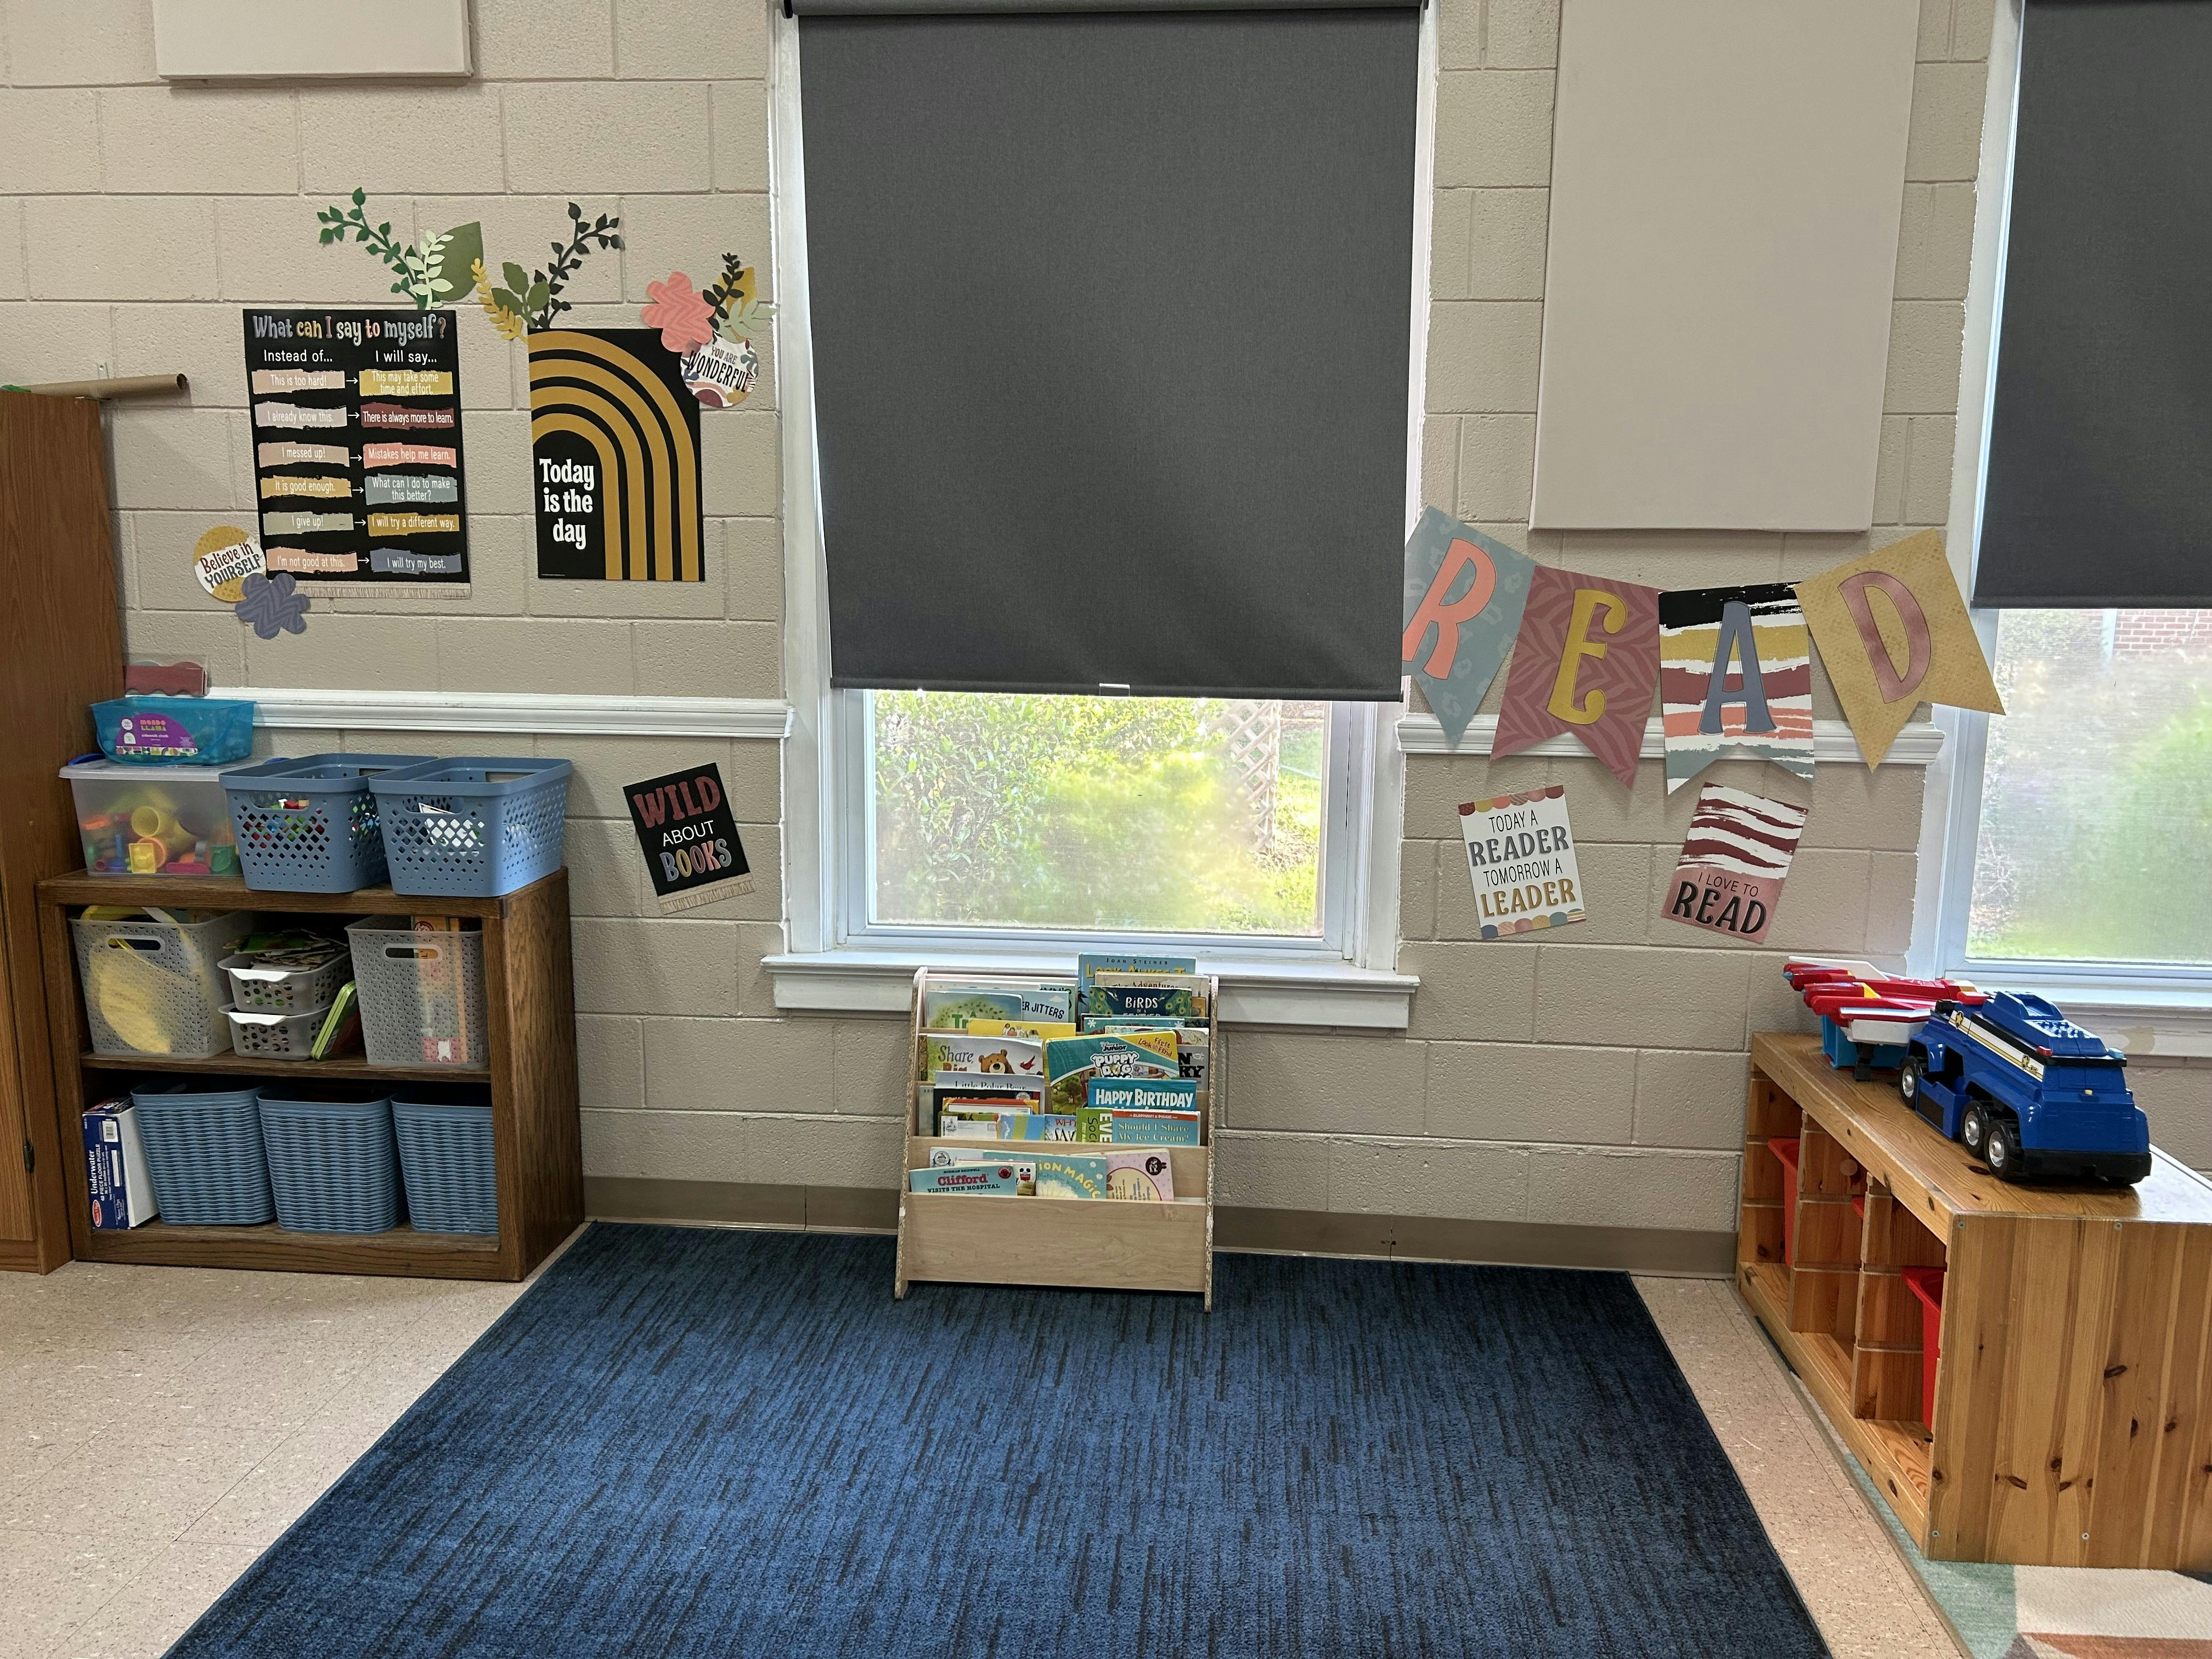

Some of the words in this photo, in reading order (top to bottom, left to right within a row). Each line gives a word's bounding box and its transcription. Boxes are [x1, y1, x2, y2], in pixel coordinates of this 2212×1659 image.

[252, 315, 292, 338] What
[296, 321, 322, 339] can
[325, 316, 332, 338] I
[337, 321, 362, 346] say
[365, 319, 380, 338] to
[264, 350, 307, 362] Instead
[313, 350, 332, 362] of...
[376, 351, 378, 362] I
[384, 349, 403, 362] will
[408, 352, 437, 365] say...
[712, 346, 723, 358] YOU
[724, 353, 737, 364] ARE
[372, 371, 386, 382] This
[388, 373, 401, 385] may
[403, 371, 417, 382] take
[420, 374, 438, 382] some
[686, 350, 749, 392] WONDERFUL
[270, 374, 284, 385] This
[287, 375, 292, 385] is
[295, 375, 306, 385] too
[308, 374, 326, 385] hard!
[381, 383, 394, 394] time
[397, 384, 409, 394] and
[411, 384, 433, 394] effort.
[268, 411, 270, 421] I
[273, 411, 297, 423] already
[300, 411, 317, 422] know
[320, 412, 334, 422] this.
[364, 411, 381, 422] There
[382, 412, 387, 422] is
[388, 412, 409, 425] always
[411, 414, 426, 423] more
[428, 413, 434, 422] to
[437, 412, 453, 423] learn.
[282, 448, 285, 457] I
[287, 448, 311, 459] messed
[313, 448, 325, 460] up!
[369, 449, 398, 459] Mistakes
[401, 449, 415, 461] help
[418, 452, 429, 460] me
[431, 449, 450, 460] learn.
[539, 459, 594, 490] Today
[275, 481, 281, 490] It
[282, 481, 288, 491] is
[290, 481, 306, 493] good
[309, 482, 335, 494] enough.
[373, 478, 390, 488] What
[393, 479, 405, 488] can
[407, 478, 409, 488] I
[411, 478, 420, 488] do
[422, 479, 429, 488] to
[432, 478, 450, 489] make
[392, 490, 404, 500] this
[407, 490, 431, 500] better?
[544, 487, 560, 512] is
[563, 489, 592, 513] the
[292, 516, 294, 526] I
[297, 517, 311, 529] give
[313, 517, 323, 529] up!
[372, 517, 374, 526] I
[377, 517, 388, 527] will
[391, 517, 400, 530] try
[408, 517, 437, 527] different
[439, 520, 455, 530] way.
[553, 518, 586, 550] day
[200, 548, 240, 574] Believe
[239, 543, 254, 555] in
[278, 556, 287, 566] I'm
[289, 557, 300, 566] not
[302, 557, 319, 568] good
[321, 557, 329, 566] at
[331, 557, 345, 567] this.
[387, 558, 390, 568] I
[392, 557, 404, 568] will
[405, 558, 415, 570] try
[417, 560, 427, 571] my
[429, 558, 445, 568] best.
[204, 554, 262, 588] YOURSELF
[633, 776, 720, 828] WILD
[1489, 811, 1525, 833] TODAY
[1531, 810, 1538, 826] A
[663, 820, 713, 847] ABOUT
[1468, 826, 1569, 867] READER
[659, 839, 731, 882] BOOKS
[1483, 860, 1549, 887] TOMORROW
[1555, 858, 1562, 874] A
[1699, 872, 1703, 882] I
[1706, 874, 1739, 891] LOVE
[1743, 884, 1758, 896] TO
[1480, 878, 1576, 918] LEADER
[1672, 881, 1767, 934] READ
[1022, 1001, 1030, 1011] R
[1032, 1003, 1064, 1019] JITTERS
[952, 1014, 969, 1028] Tr
[938, 1045, 974, 1064] Share,
[1094, 1053, 1137, 1067] PUPPY
[1102, 1064, 1132, 1076] DG
[1096, 1088, 1133, 1106] HAPPY
[1135, 1088, 1193, 1108] BIRTHDAY
[1118, 1123, 1150, 1131] Should
[1119, 1133, 1131, 1141] My
[1154, 1134, 1189, 1142] Cream?
[89, 1150, 98, 1194] Underwater
[938, 1174, 988, 1186] Clifford
